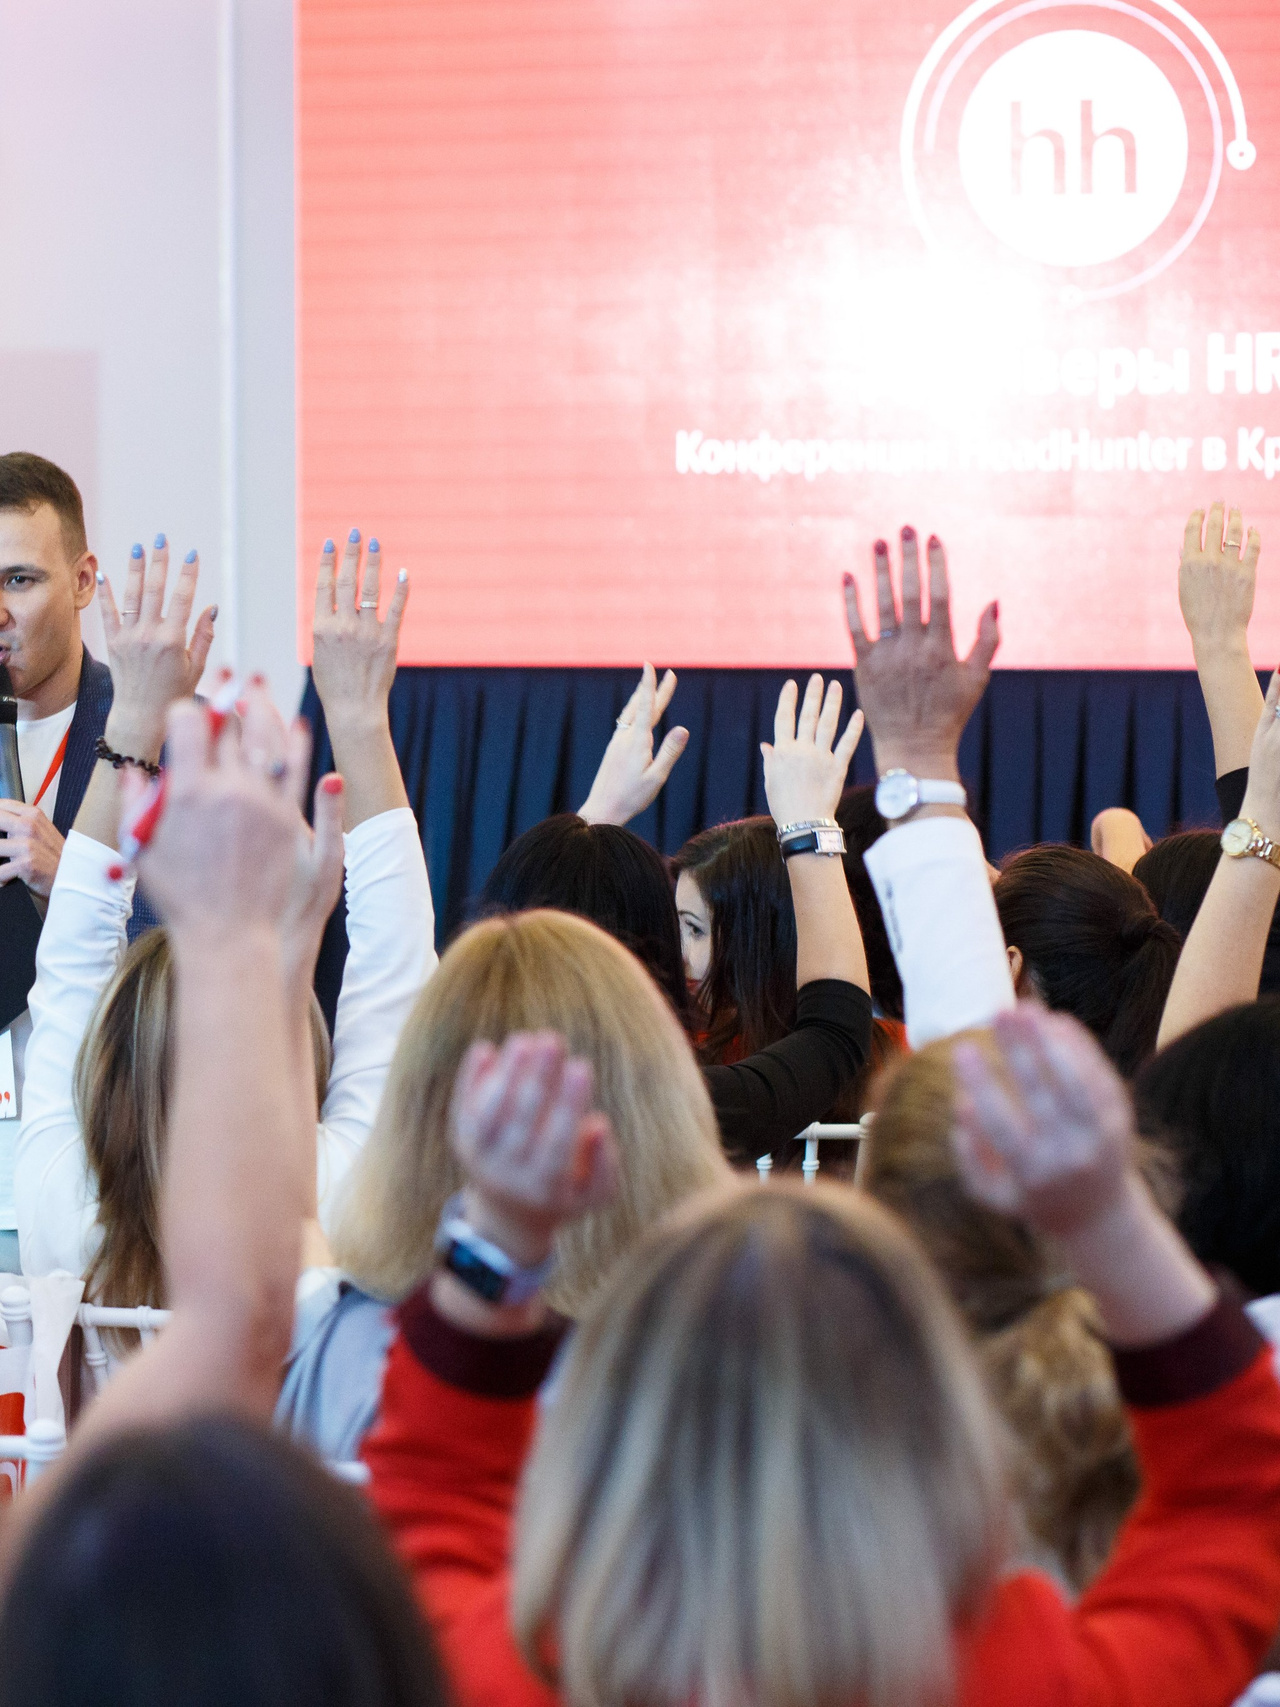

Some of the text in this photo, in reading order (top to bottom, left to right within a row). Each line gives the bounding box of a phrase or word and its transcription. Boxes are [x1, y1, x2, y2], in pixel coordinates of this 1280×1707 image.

[1011, 100, 1137, 194] hh
[675, 429, 949, 481] Конференция
[1201, 436, 1227, 471] в
